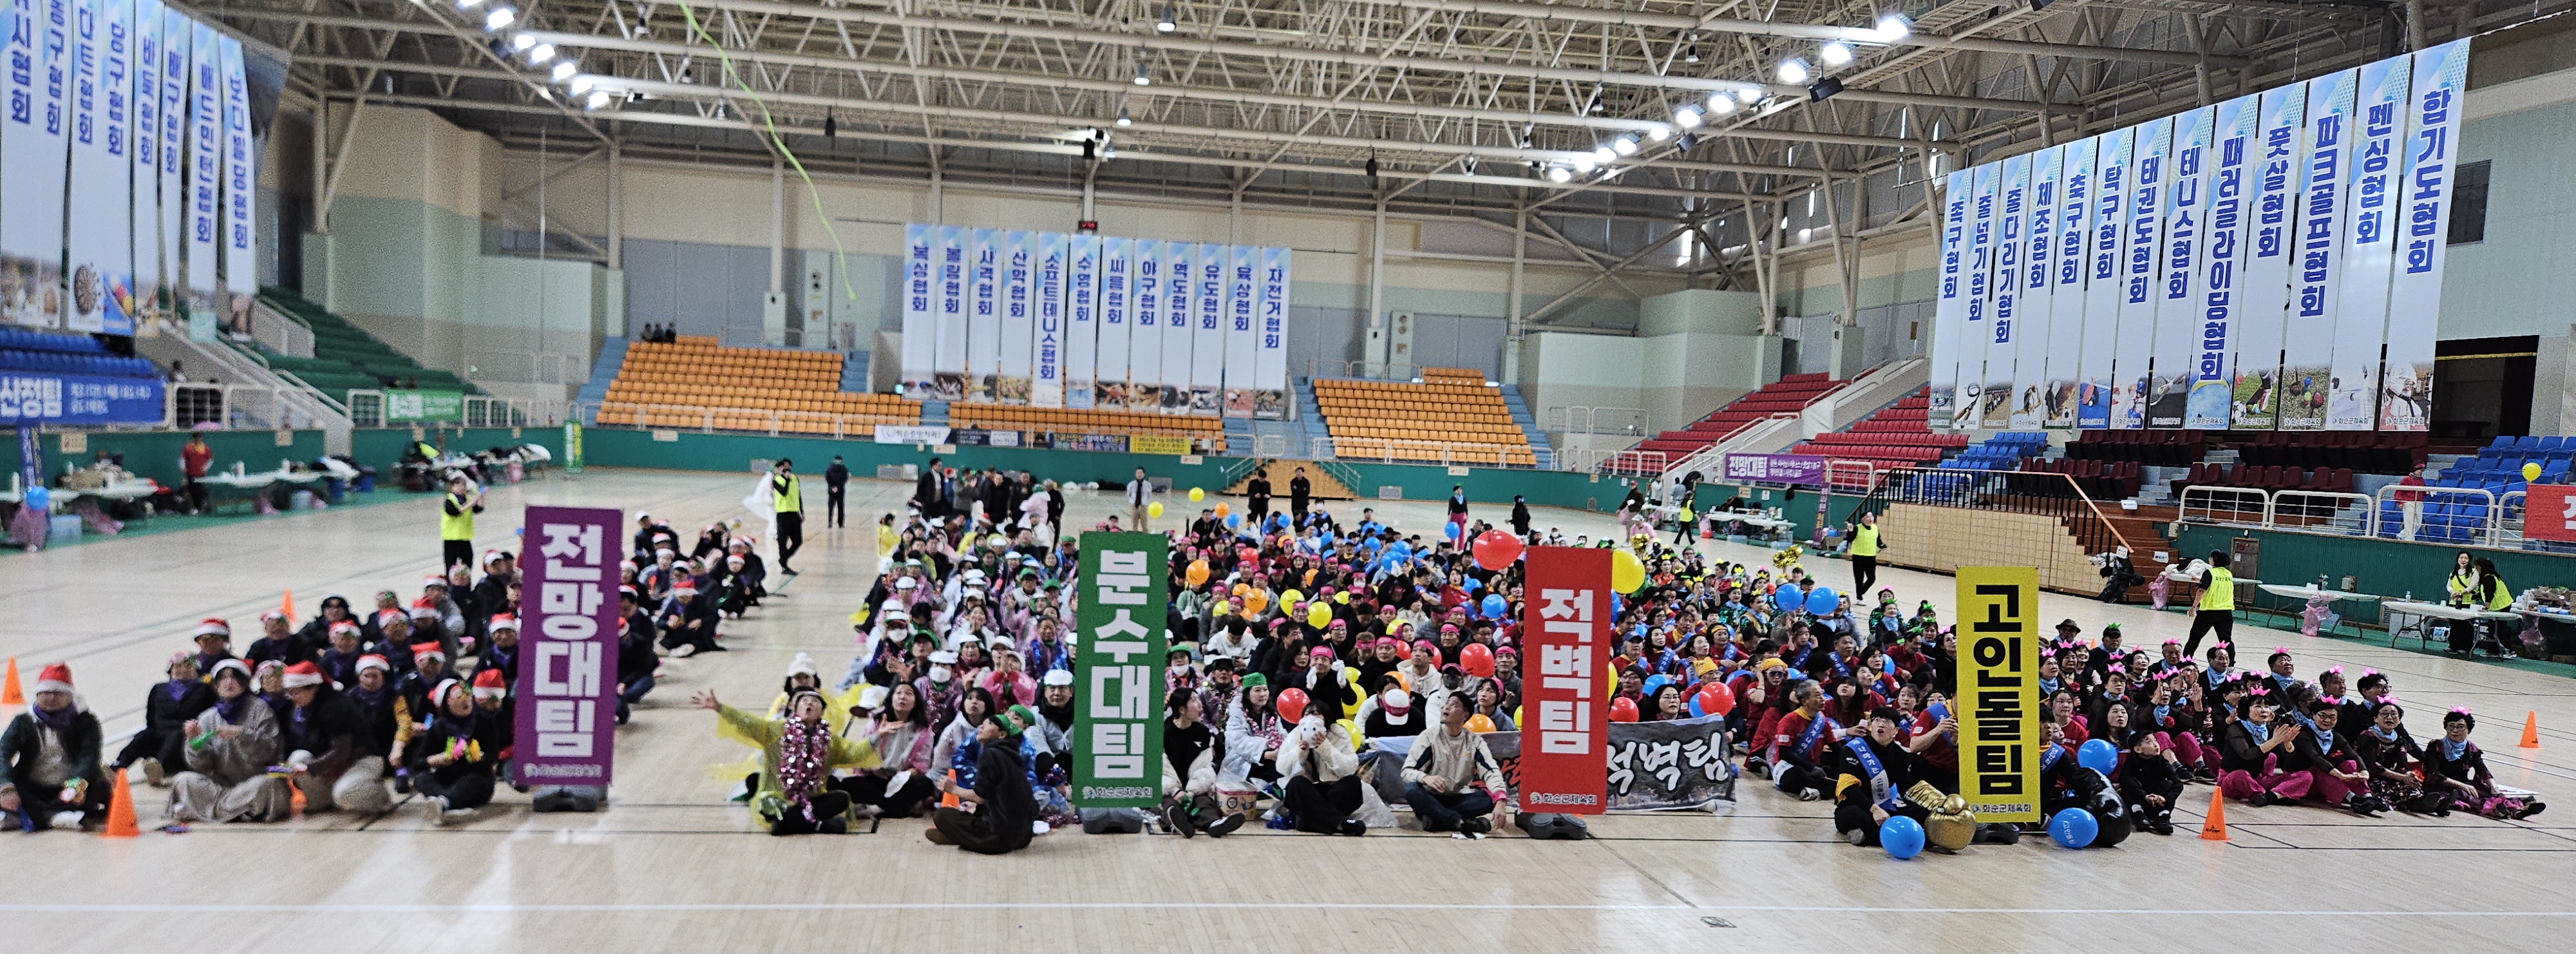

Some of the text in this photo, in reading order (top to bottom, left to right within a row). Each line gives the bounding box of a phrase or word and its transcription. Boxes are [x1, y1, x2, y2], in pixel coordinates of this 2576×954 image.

[12, 0, 32, 124] 시협회
[2061, 173, 2087, 284] 축구협회
[2096, 164, 2123, 280] 탁구협회
[2168, 145, 2201, 300] 테니스협회
[2258, 124, 2292, 258] 풋살협회
[2300, 113, 2341, 317] 파크골프협회
[2356, 101, 2395, 245] 펜싱협회
[2407, 88, 2451, 274] 합기도협회
[912, 245, 929, 312] 복싱협회
[945, 247, 961, 314] 볼링협회
[978, 249, 995, 316] 사격협회
[1010, 251, 1027, 318] 산악협회
[1944, 200, 1964, 299] 족구협회
[1969, 195, 1992, 321] 줄넘기협회
[1995, 187, 2022, 343] 줄다리기협회
[2030, 180, 2053, 289] 체조협회
[2129, 155, 2161, 303] 태권도협회
[2200, 136, 2245, 381] 패러글라이딩협회
[1041, 255, 1059, 379] 소프트테니스협회
[1076, 256, 1092, 321] 수영협회
[1108, 258, 1124, 324] 씨름협회
[1140, 260, 1157, 325] 야구협회
[1171, 262, 1188, 327] 역도협회
[1202, 264, 1220, 329] 유도협회
[1235, 266, 1252, 331] 육상협회
[1265, 268, 1283, 348] 자전거협회
[1729, 456, 1768, 477] 전망대팀
[534, 524, 603, 757] 전망대팀
[1090, 550, 1150, 778] 분수대팀
[1539, 588, 1593, 754] 적벽팀
[1973, 584, 2023, 796] 고인돌팀
[1542, 794, 1597, 804] 화순군체육회
[1982, 803, 2031, 814] 화순군체육회
